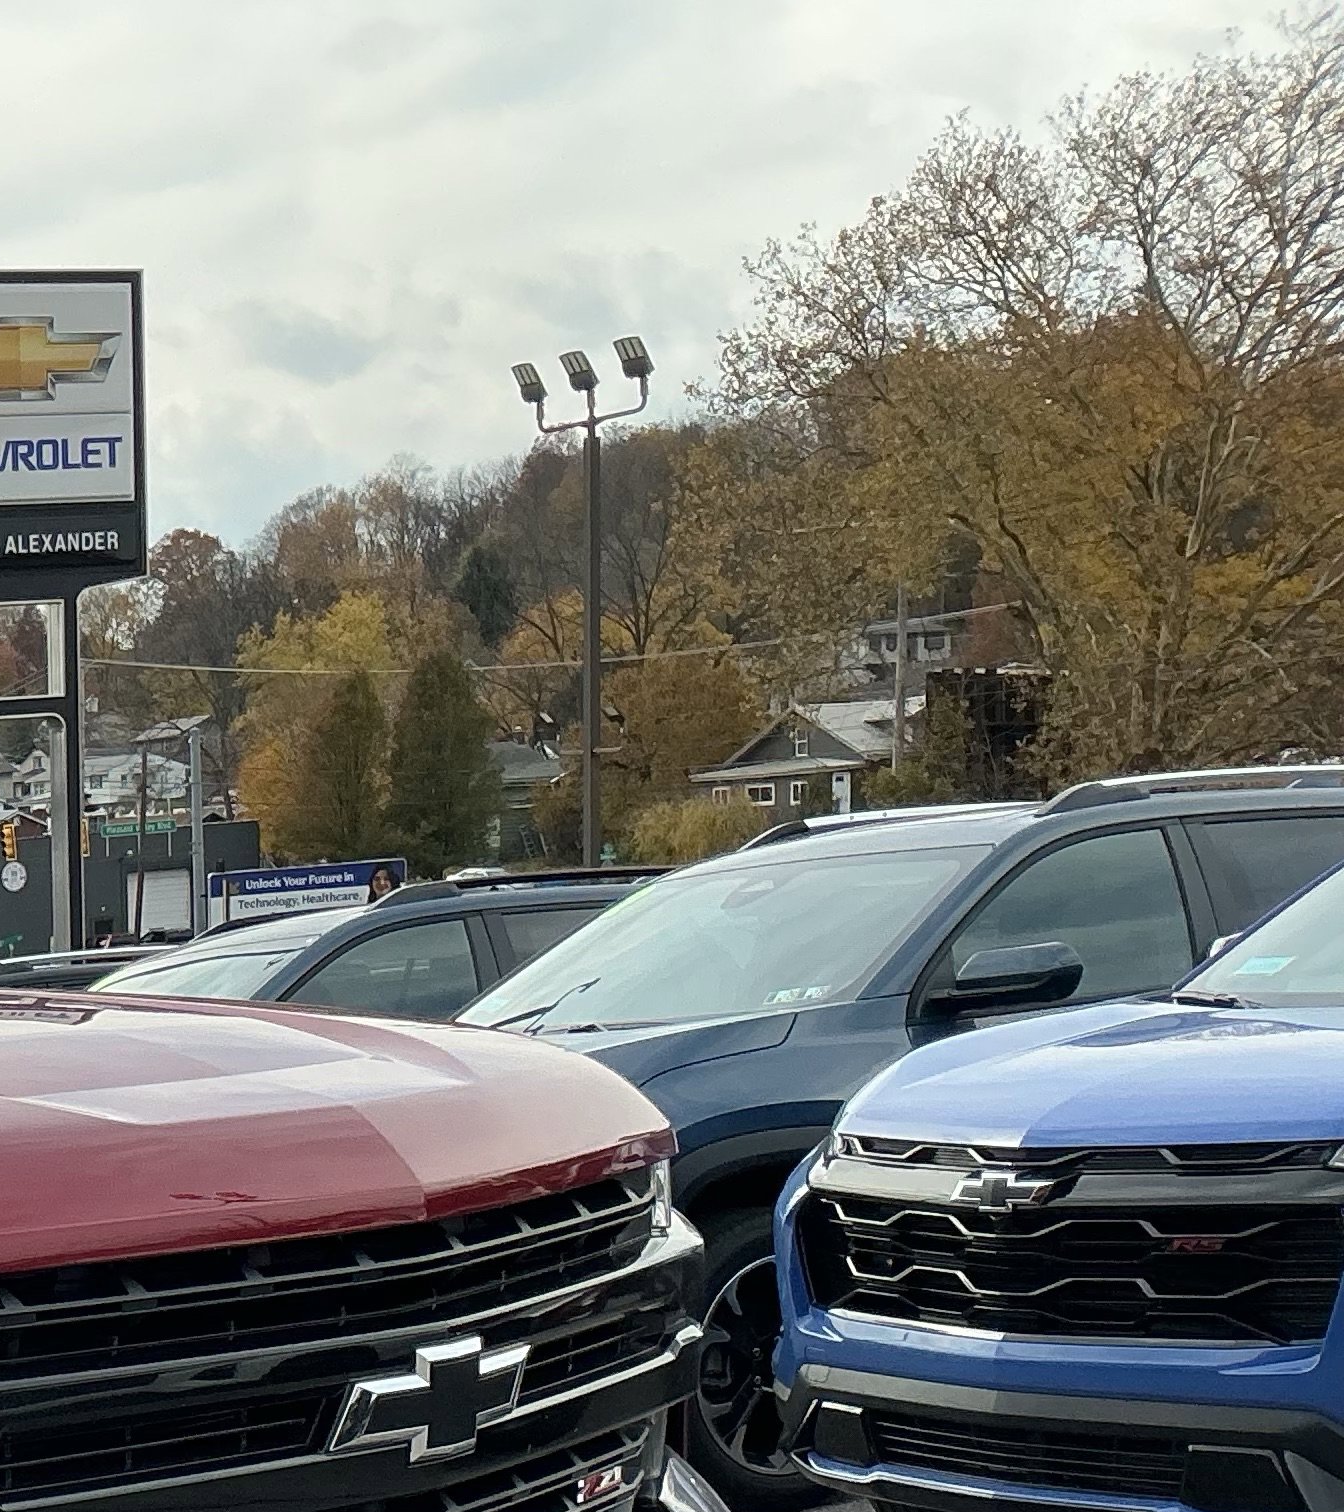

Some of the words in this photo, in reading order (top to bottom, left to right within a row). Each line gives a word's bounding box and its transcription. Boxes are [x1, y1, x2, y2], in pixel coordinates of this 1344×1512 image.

[4, 531, 119, 555] ALEXANDER
[245, 877, 281, 890] Unlock
[282, 876, 307, 887] Your
[308, 873, 344, 885] Future
[1167, 1238, 1226, 1251] RS
